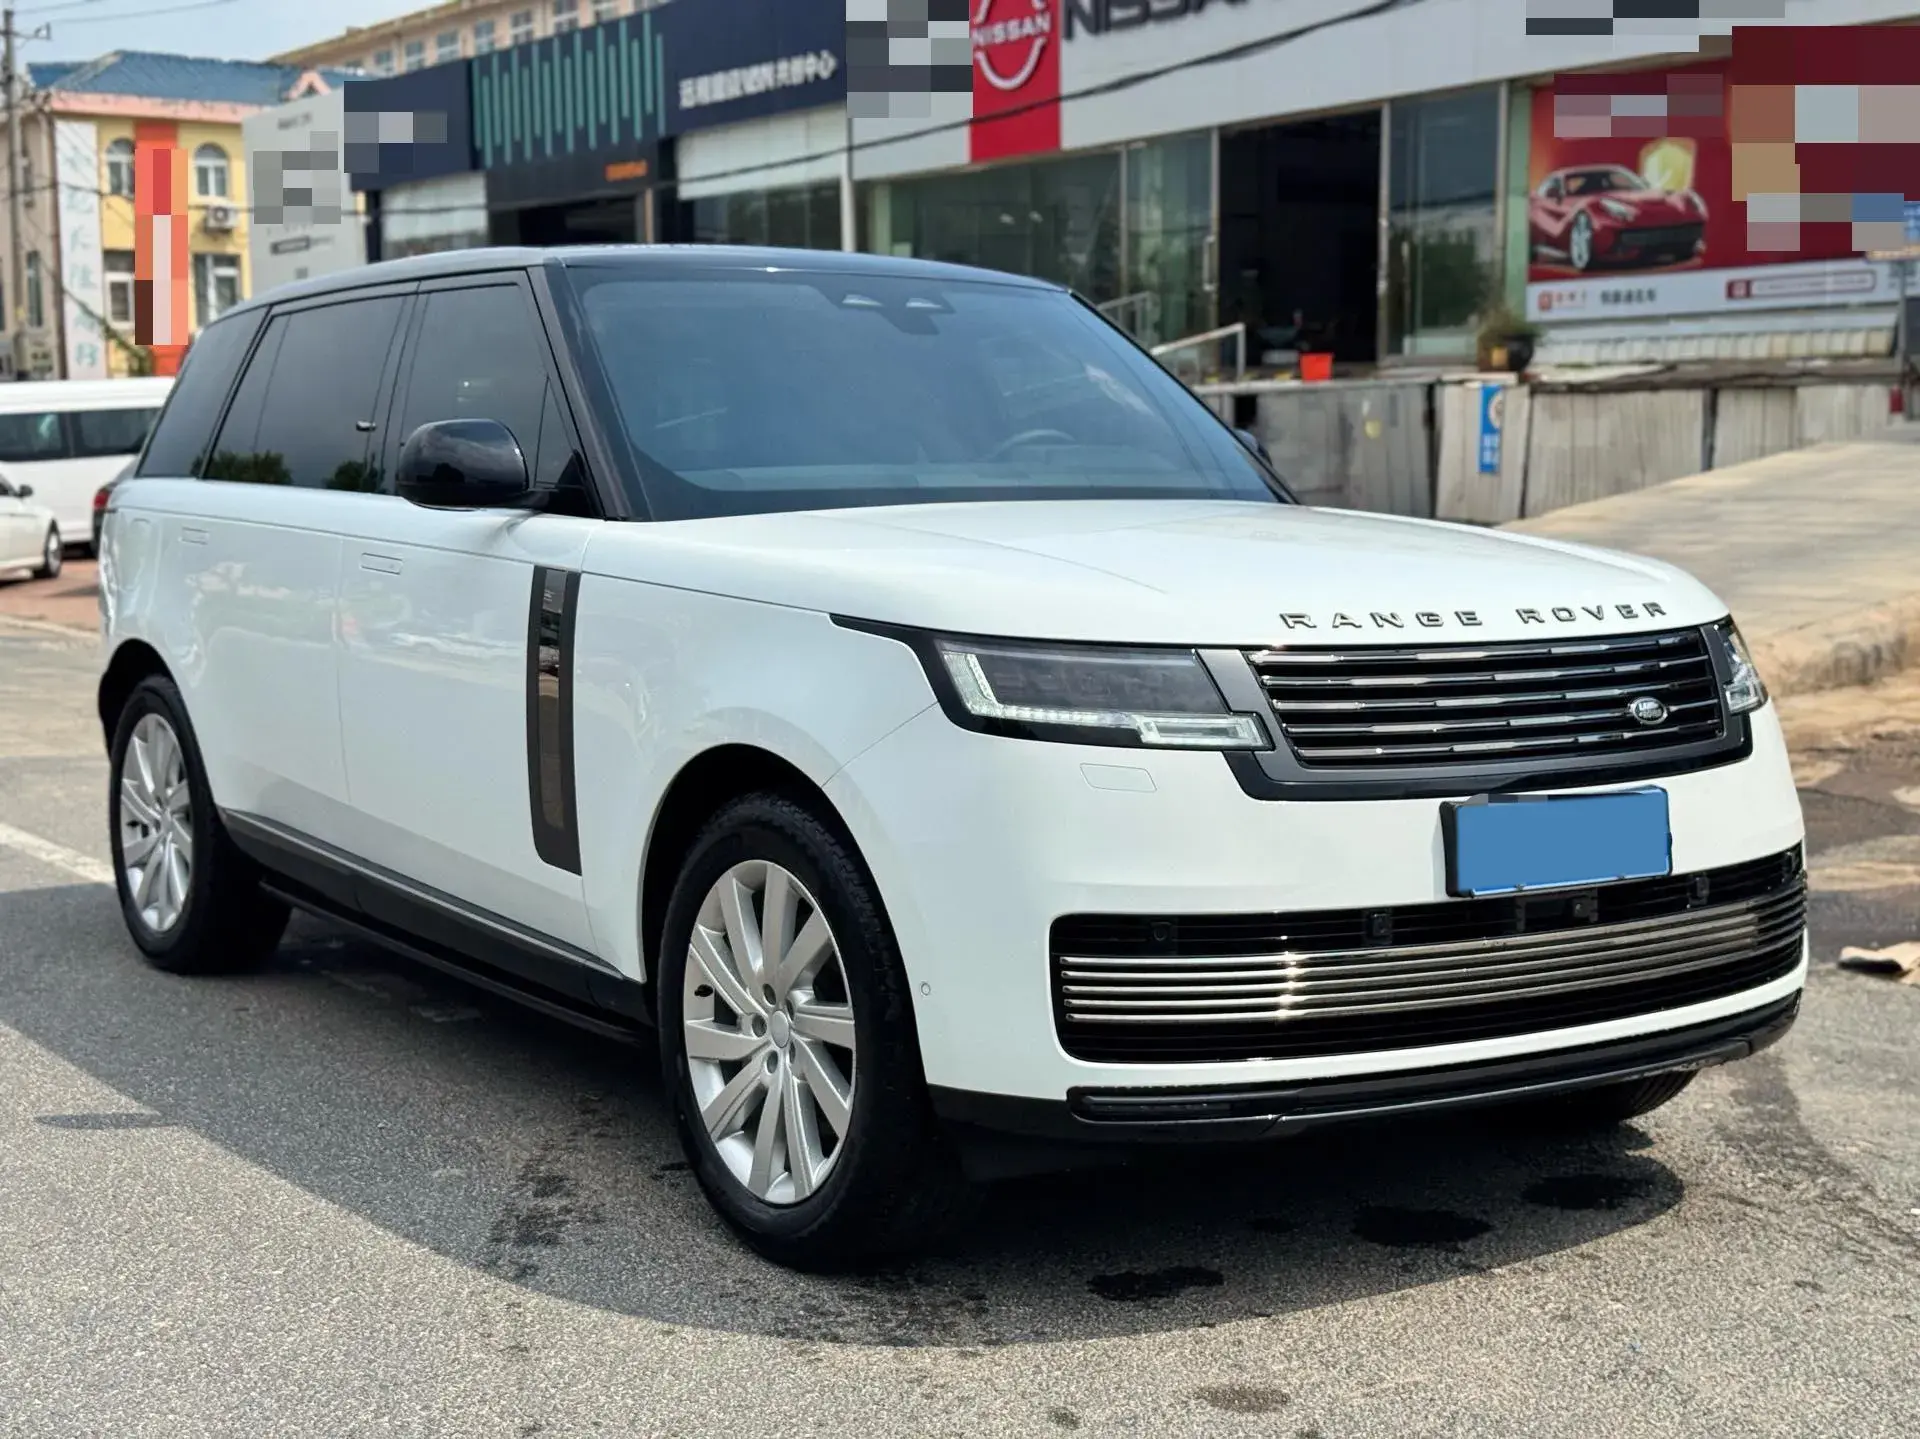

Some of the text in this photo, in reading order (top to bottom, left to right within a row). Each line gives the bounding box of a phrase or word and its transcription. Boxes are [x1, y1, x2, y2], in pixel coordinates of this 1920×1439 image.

[972, 14, 1050, 46] NISSAN
[1279, 602, 1667, 629] RANGE ROVER
